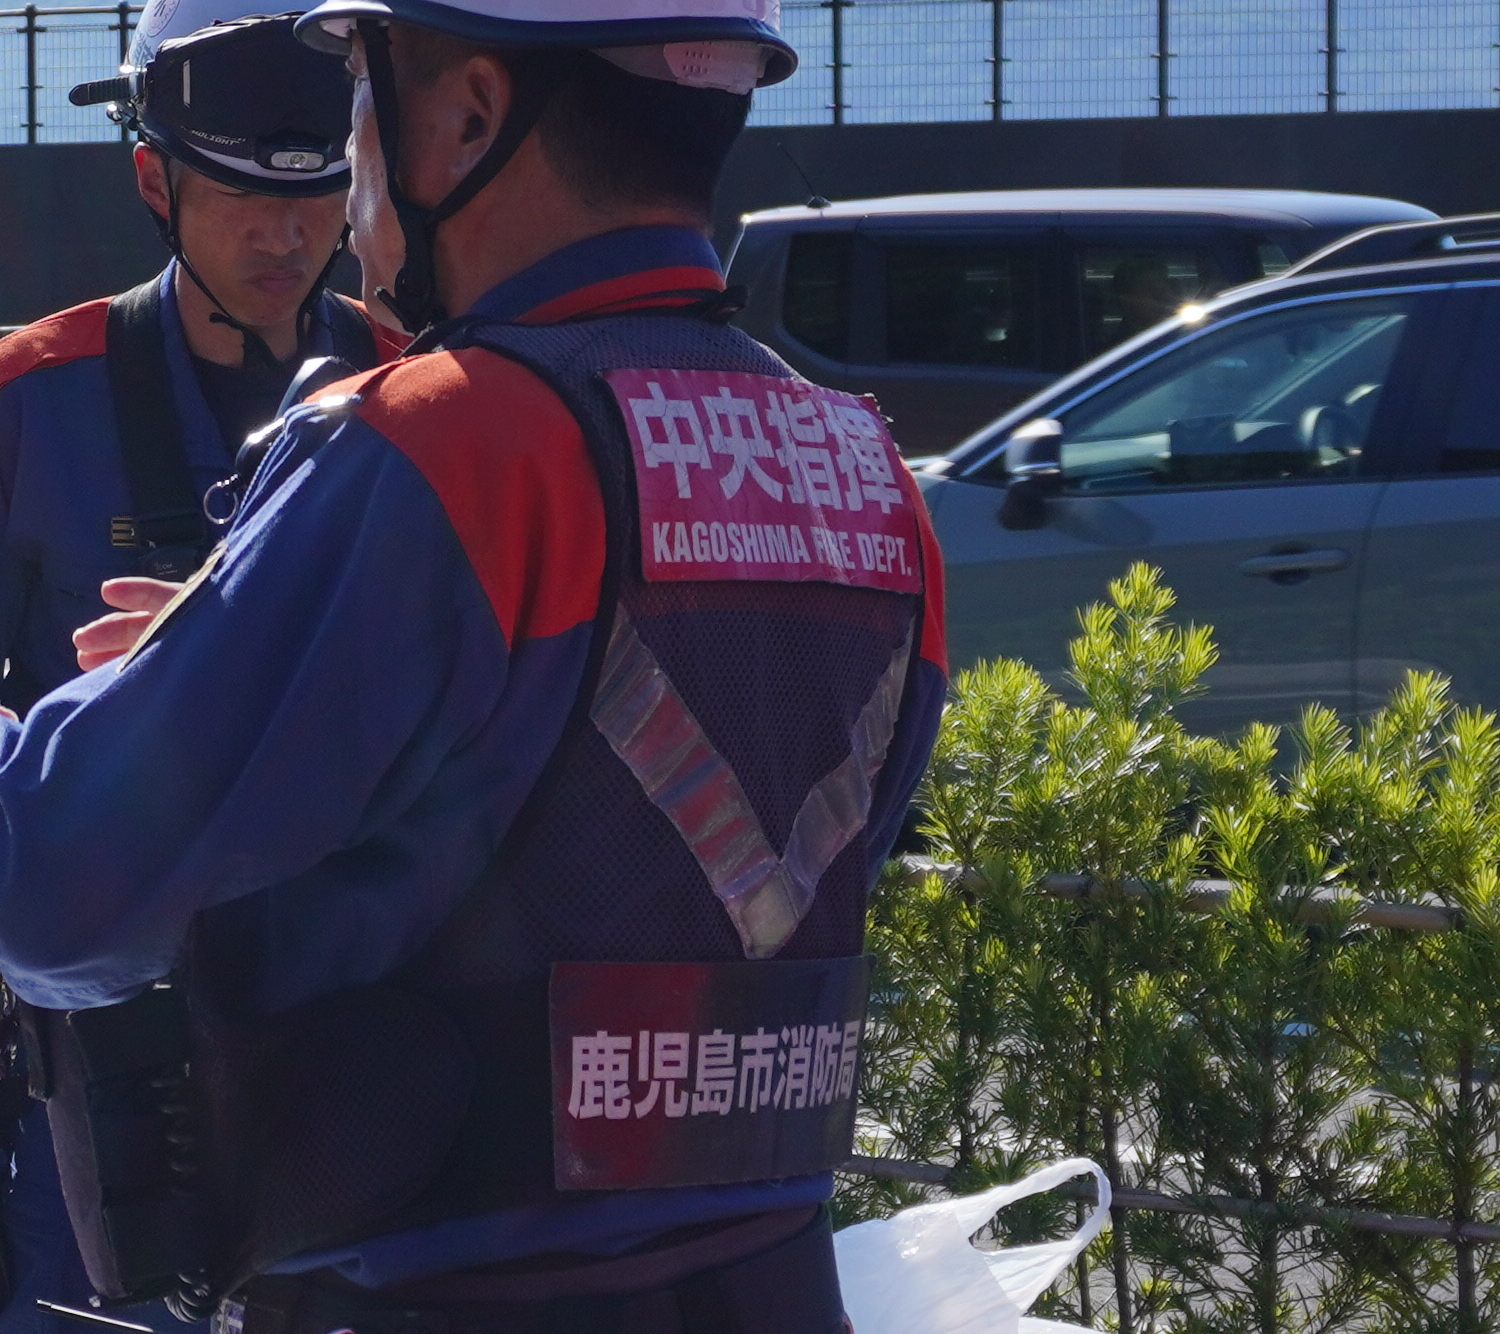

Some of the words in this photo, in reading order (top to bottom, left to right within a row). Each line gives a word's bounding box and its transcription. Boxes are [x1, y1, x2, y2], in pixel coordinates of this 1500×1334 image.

[627, 380, 904, 515] 中央指揮
[651, 520, 810, 564] KAGOSHIMA
[811, 525, 856, 571] FIRE
[567, 1018, 863, 1121] 鹿児島市消防局
